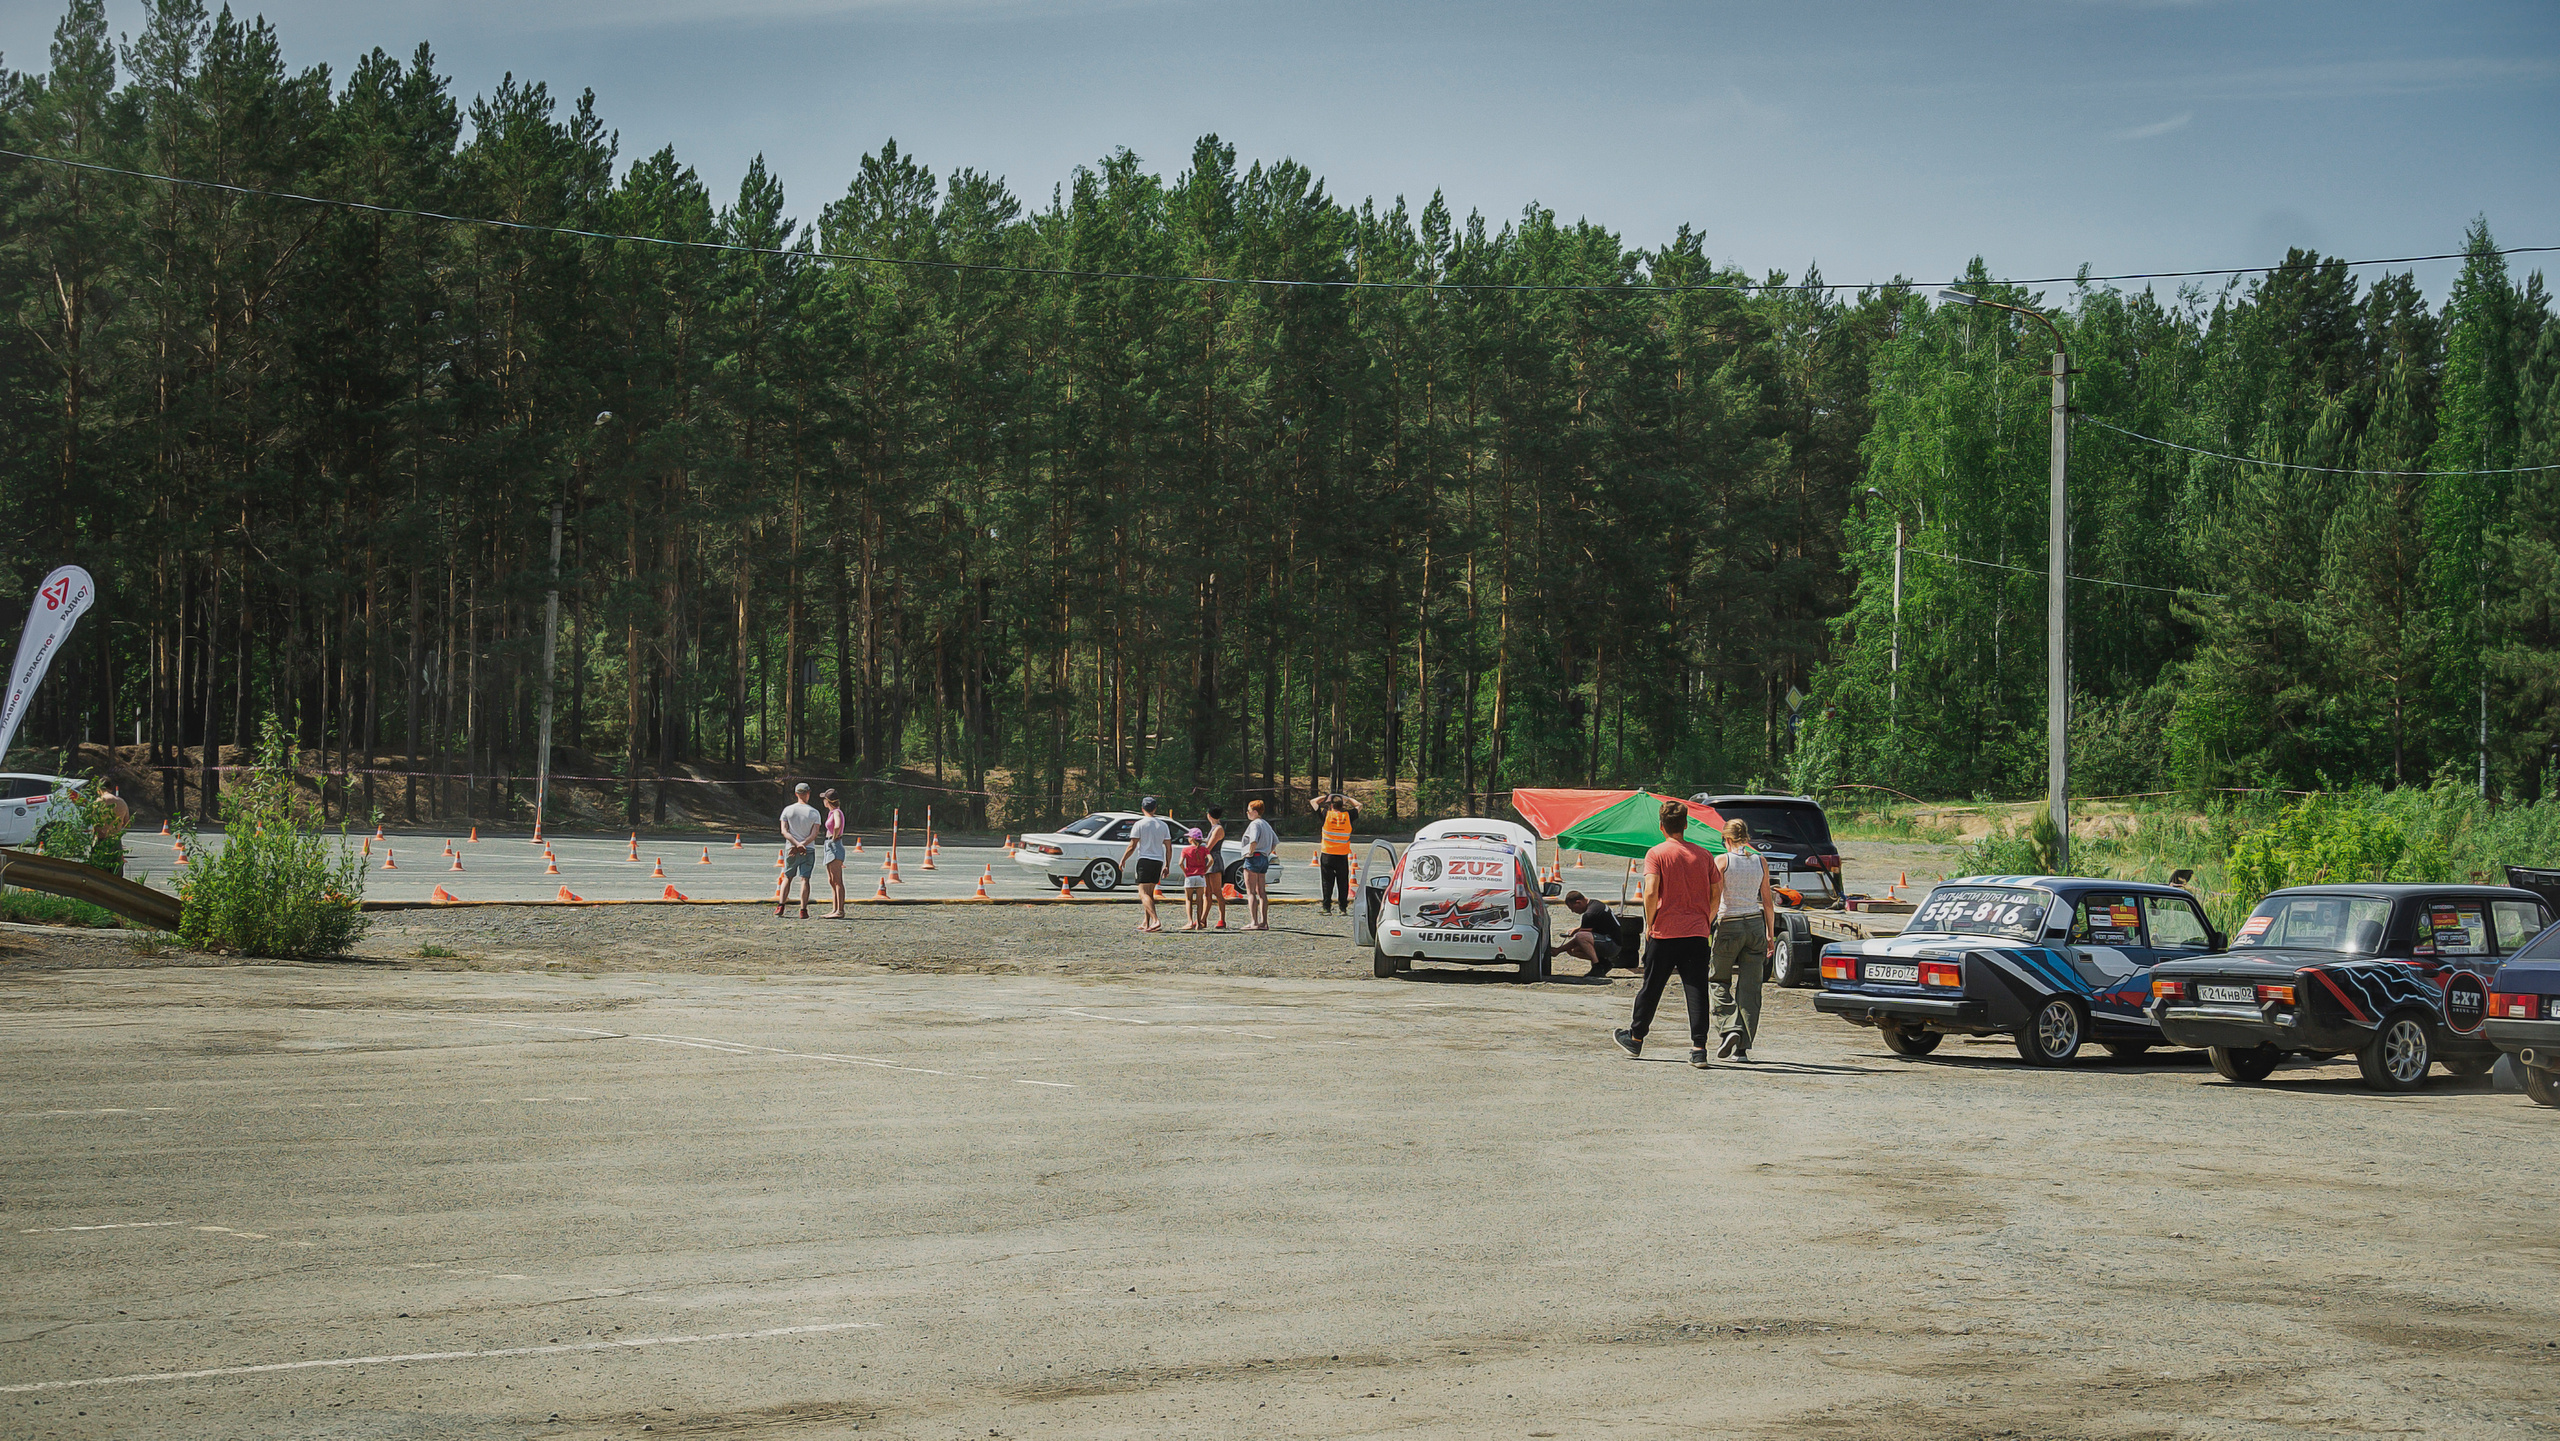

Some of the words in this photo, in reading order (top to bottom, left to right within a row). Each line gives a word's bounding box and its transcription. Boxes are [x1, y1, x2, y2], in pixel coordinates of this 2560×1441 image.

[1, 689, 23, 730] ГЛАВНОЕ
[23, 633, 55, 684] ОБЛАСТНОЕ
[1448, 861, 1503, 876] ZUZ
[1935, 892, 1980, 902] ЗАПЧАСТИ
[1979, 892, 2003, 902] ДЛЯ
[2001, 894, 2029, 904] LADA
[1922, 901, 2024, 925] 555-816
[1418, 932, 1496, 944] ЧЕЛЯБИНСК
[1906, 967, 1916, 976] 72
[2241, 988, 2253, 997] 02
[2452, 991, 2480, 1006] EXT
